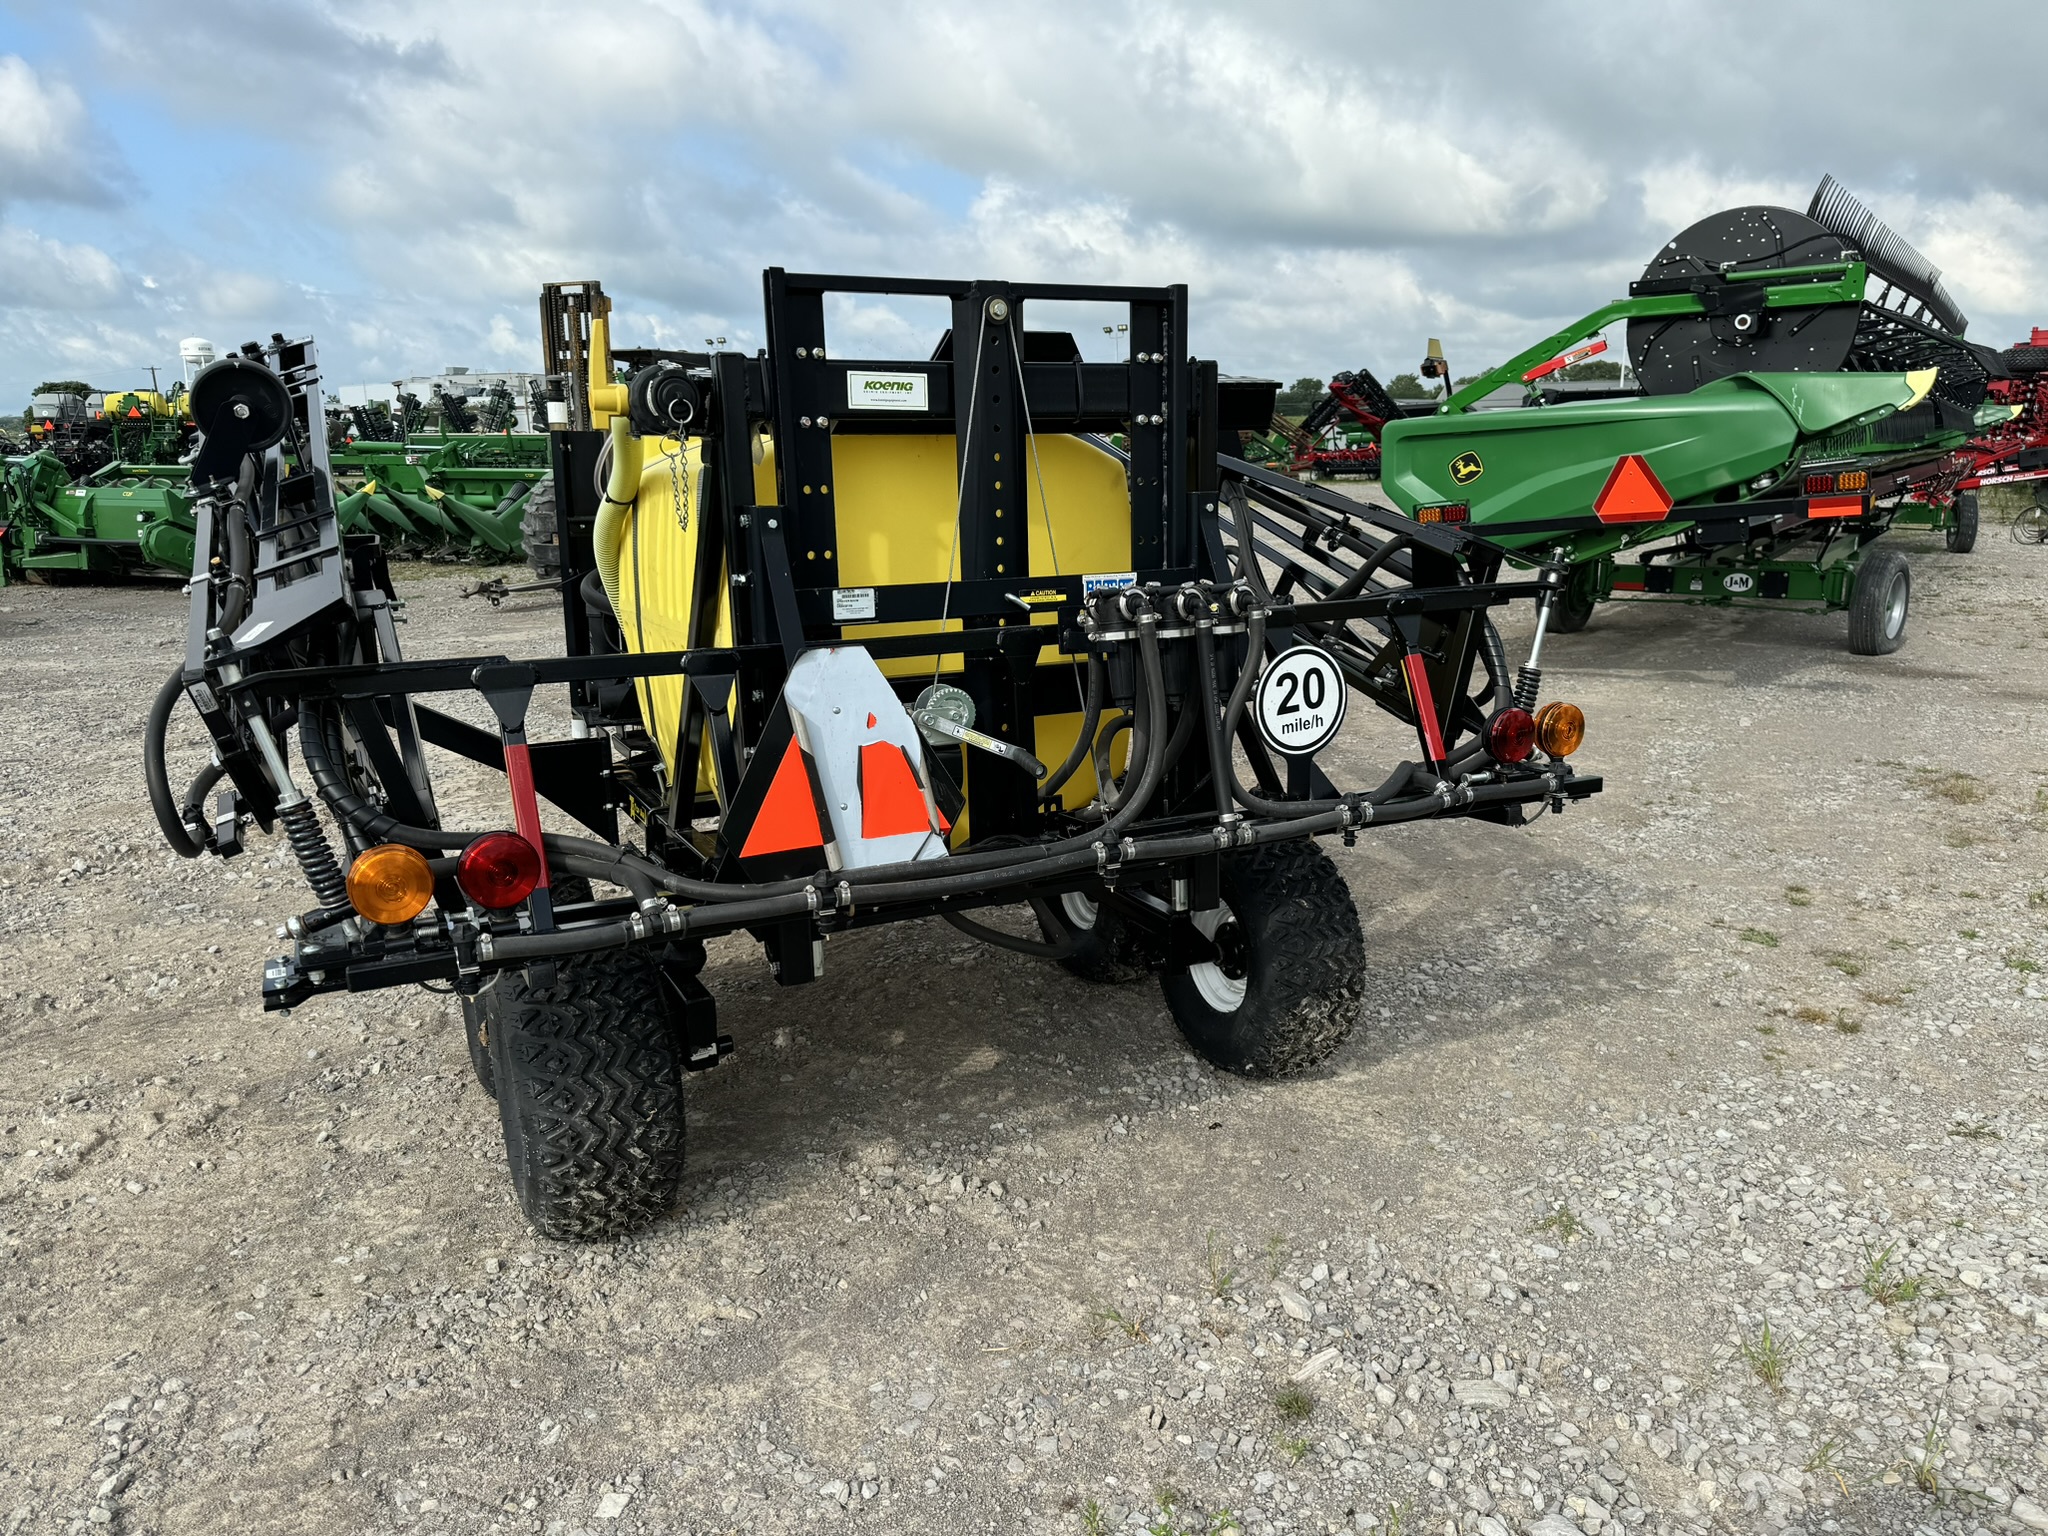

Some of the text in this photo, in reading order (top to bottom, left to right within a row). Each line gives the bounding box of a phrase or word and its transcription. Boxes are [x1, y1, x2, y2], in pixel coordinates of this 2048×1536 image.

[1980, 475, 2013, 486] HORSCH
[1725, 576, 1750, 588] J&M
[1035, 589, 1057, 597] CAUTION
[1275, 667, 1326, 716] 20
[1281, 714, 1324, 735] mile/h
